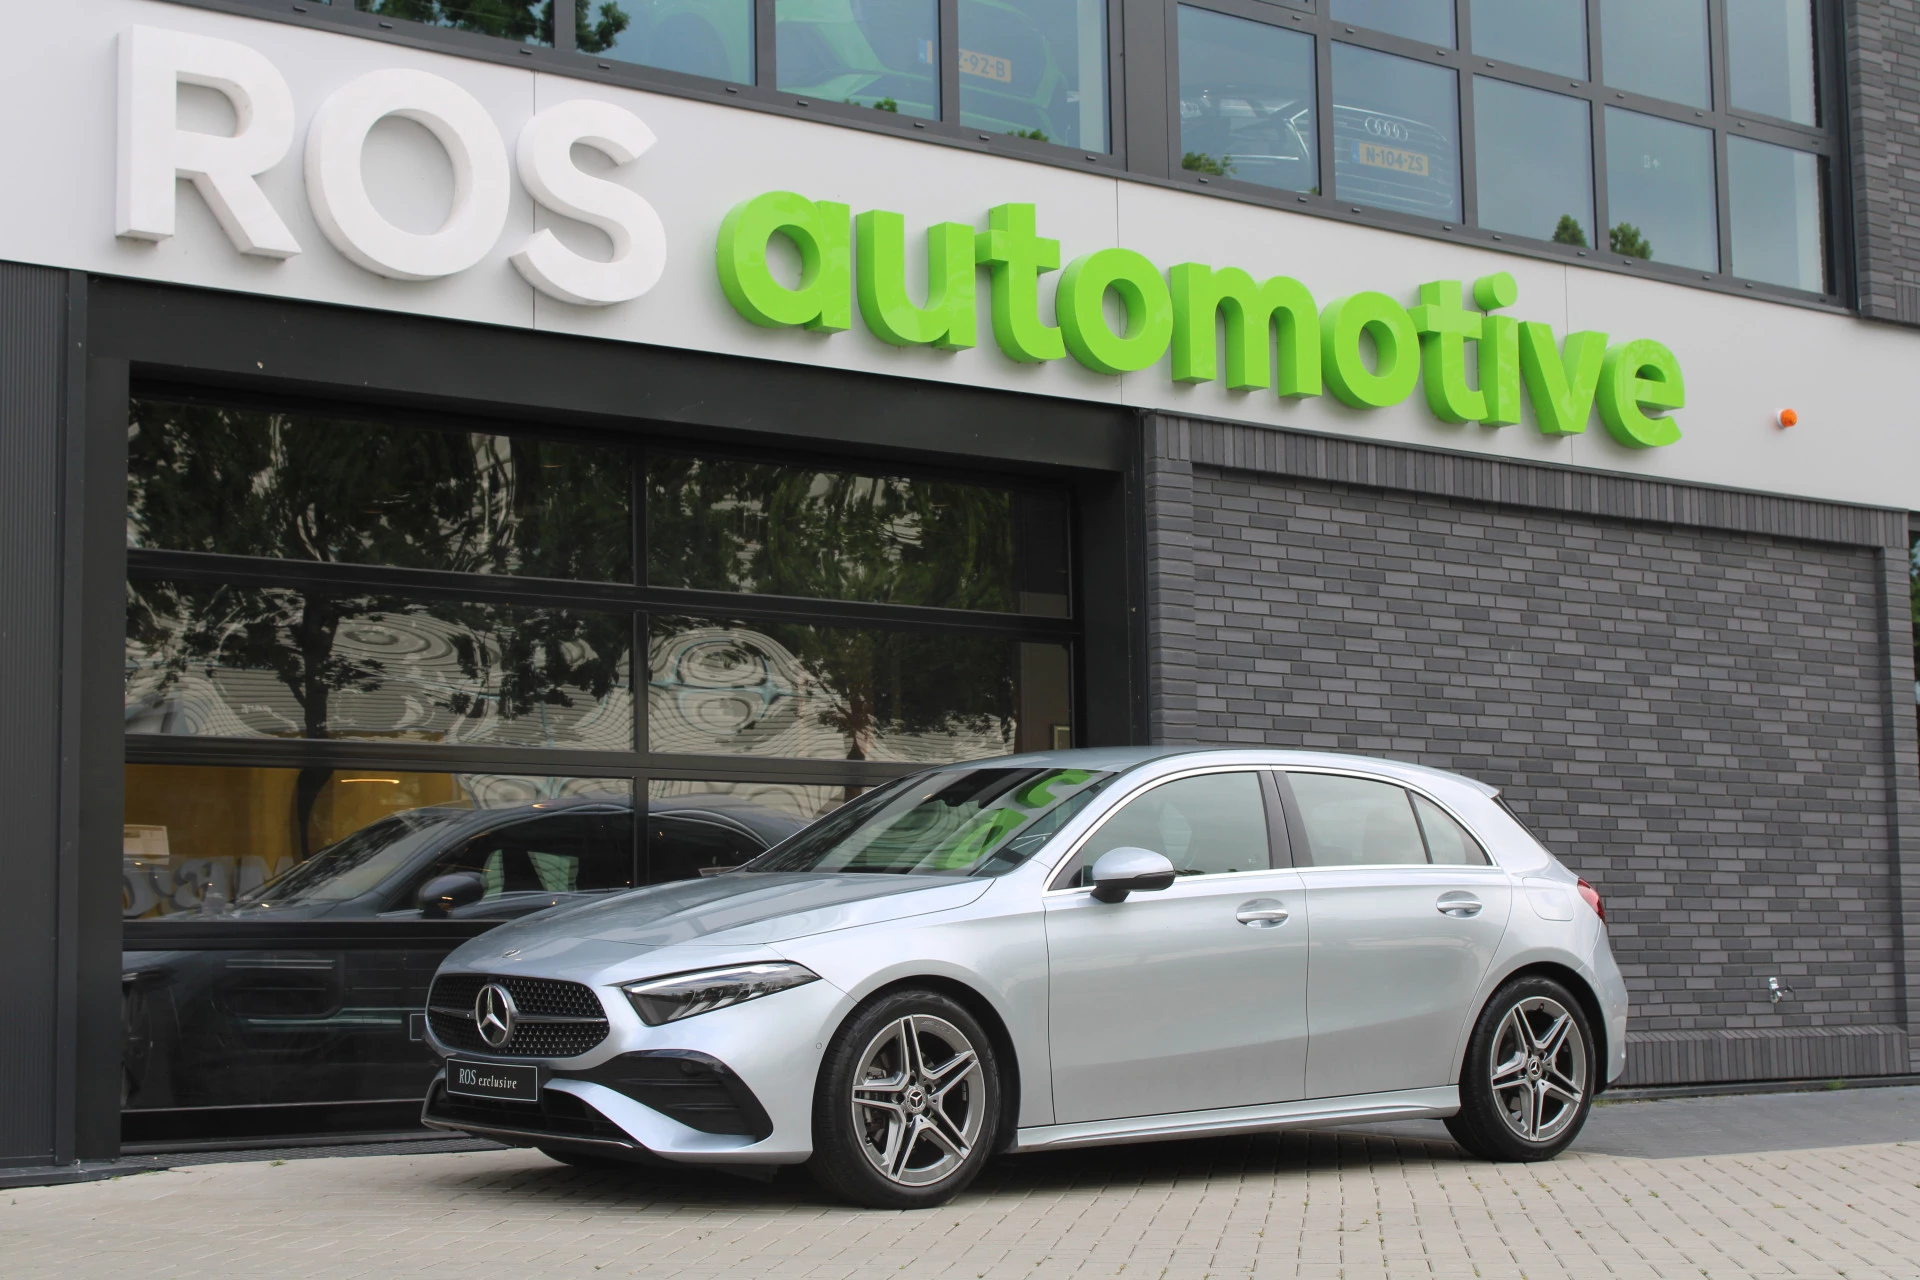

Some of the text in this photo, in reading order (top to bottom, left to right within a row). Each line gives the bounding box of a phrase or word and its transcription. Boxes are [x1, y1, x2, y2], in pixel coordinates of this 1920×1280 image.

[1365, 146, 1424, 172] N-104-ZS
[115, 24, 1685, 449] ROS automotive
[458, 1068, 517, 1090] ROS exclusive
